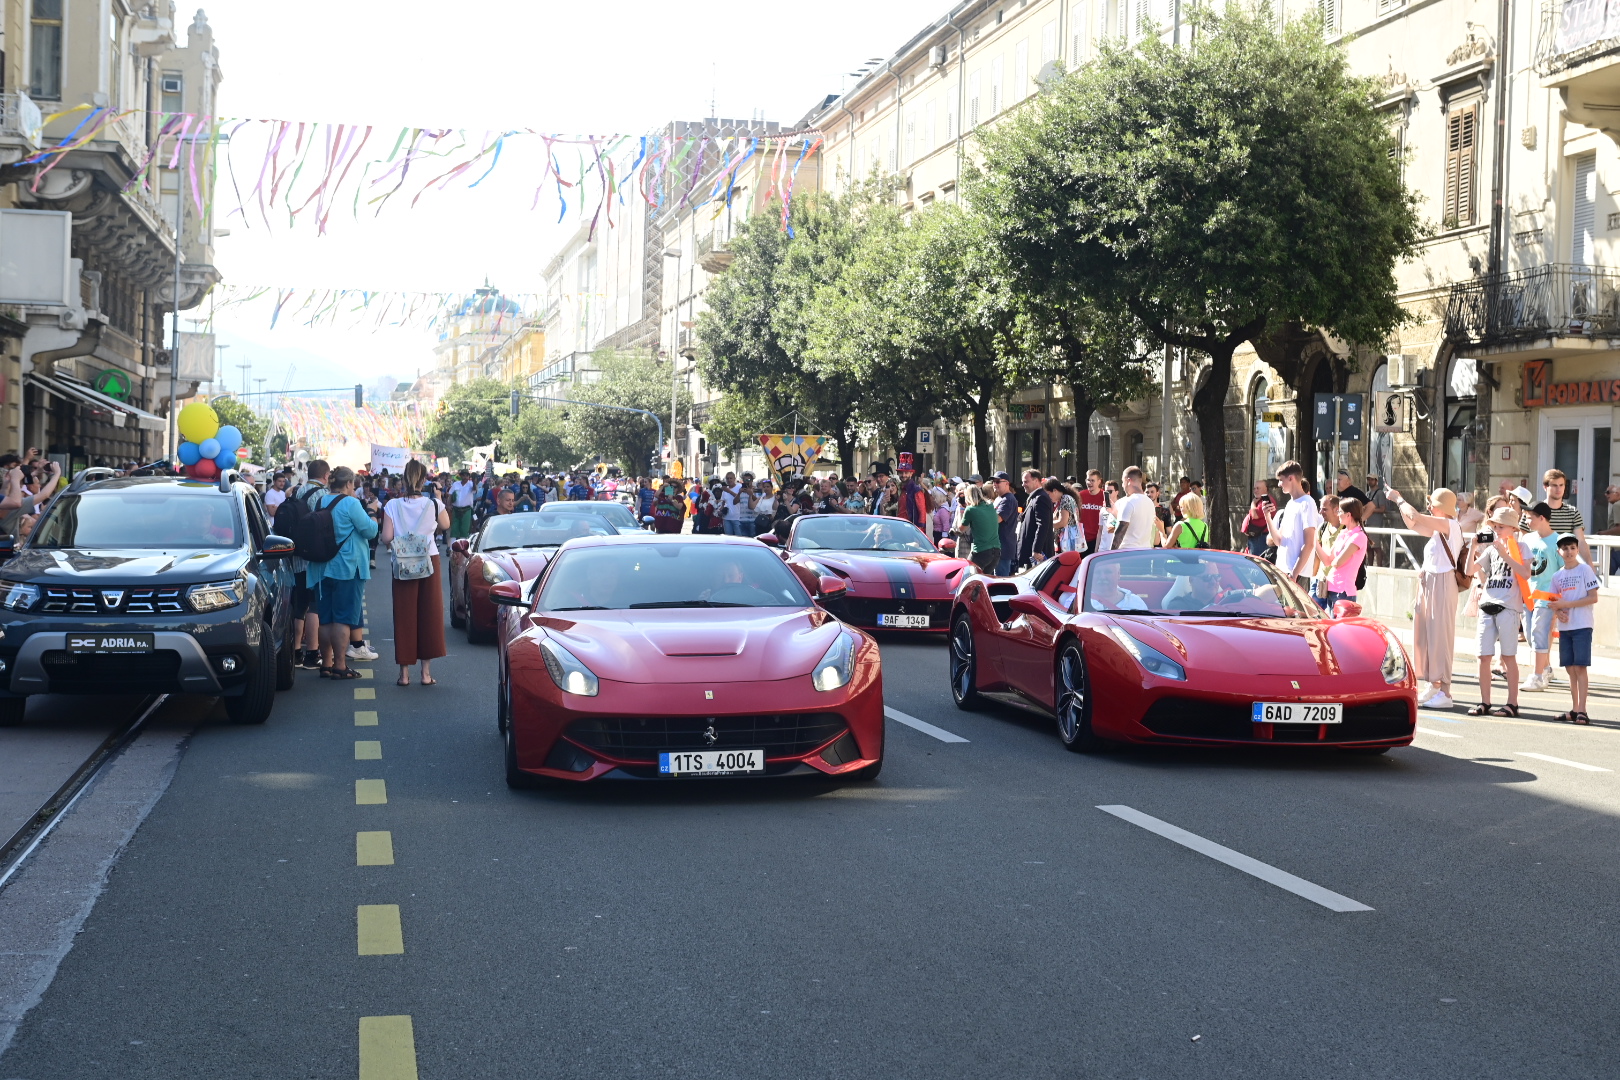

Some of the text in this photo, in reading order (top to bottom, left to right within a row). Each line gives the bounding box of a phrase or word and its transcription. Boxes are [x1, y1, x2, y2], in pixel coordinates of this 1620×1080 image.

[884, 615, 899, 624] 9AF
[906, 616, 926, 625] 1348
[101, 638, 135, 648] ADRIA
[1265, 705, 1336, 721] 6AD 7209
[674, 752, 756, 771] 1TS 4004
